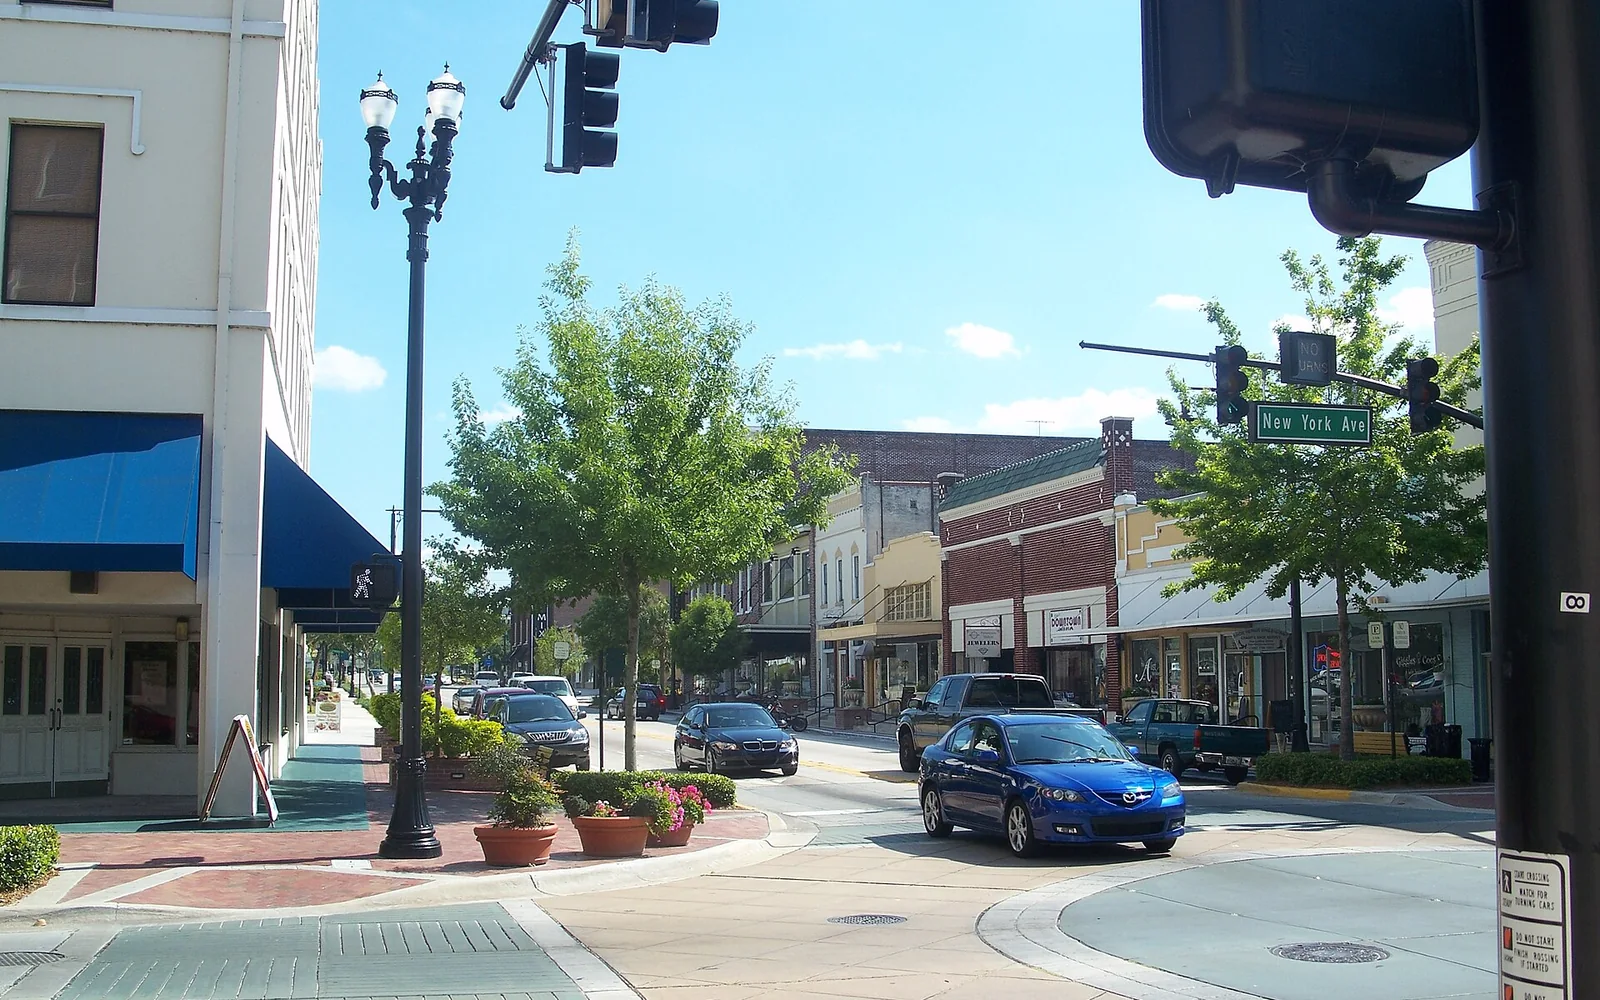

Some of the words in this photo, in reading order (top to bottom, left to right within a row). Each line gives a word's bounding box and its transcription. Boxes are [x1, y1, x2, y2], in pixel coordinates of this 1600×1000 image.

[1300, 342, 1319, 356] NO
[1298, 360, 1328, 374] URNS
[1263, 413, 1291, 430] New
[1302, 414, 1331, 431] York
[1341, 416, 1365, 432] Ave
[1527, 871, 1550, 883] CROSSING
[1519, 888, 1535, 898] WATCH
[1537, 890, 1548, 900] FOR
[1515, 897, 1536, 909] TURNING
[1539, 901, 1555, 911] CARS
[1516, 932, 1523, 942] DO
[1524, 934, 1535, 944] NOT
[1536, 935, 1555, 947] START
[1533, 951, 1559, 964] ROSSING
[1520, 960, 1525, 968] IF
[1526, 961, 1549, 973] STARTED
[1524, 992, 1532, 1000] DO
